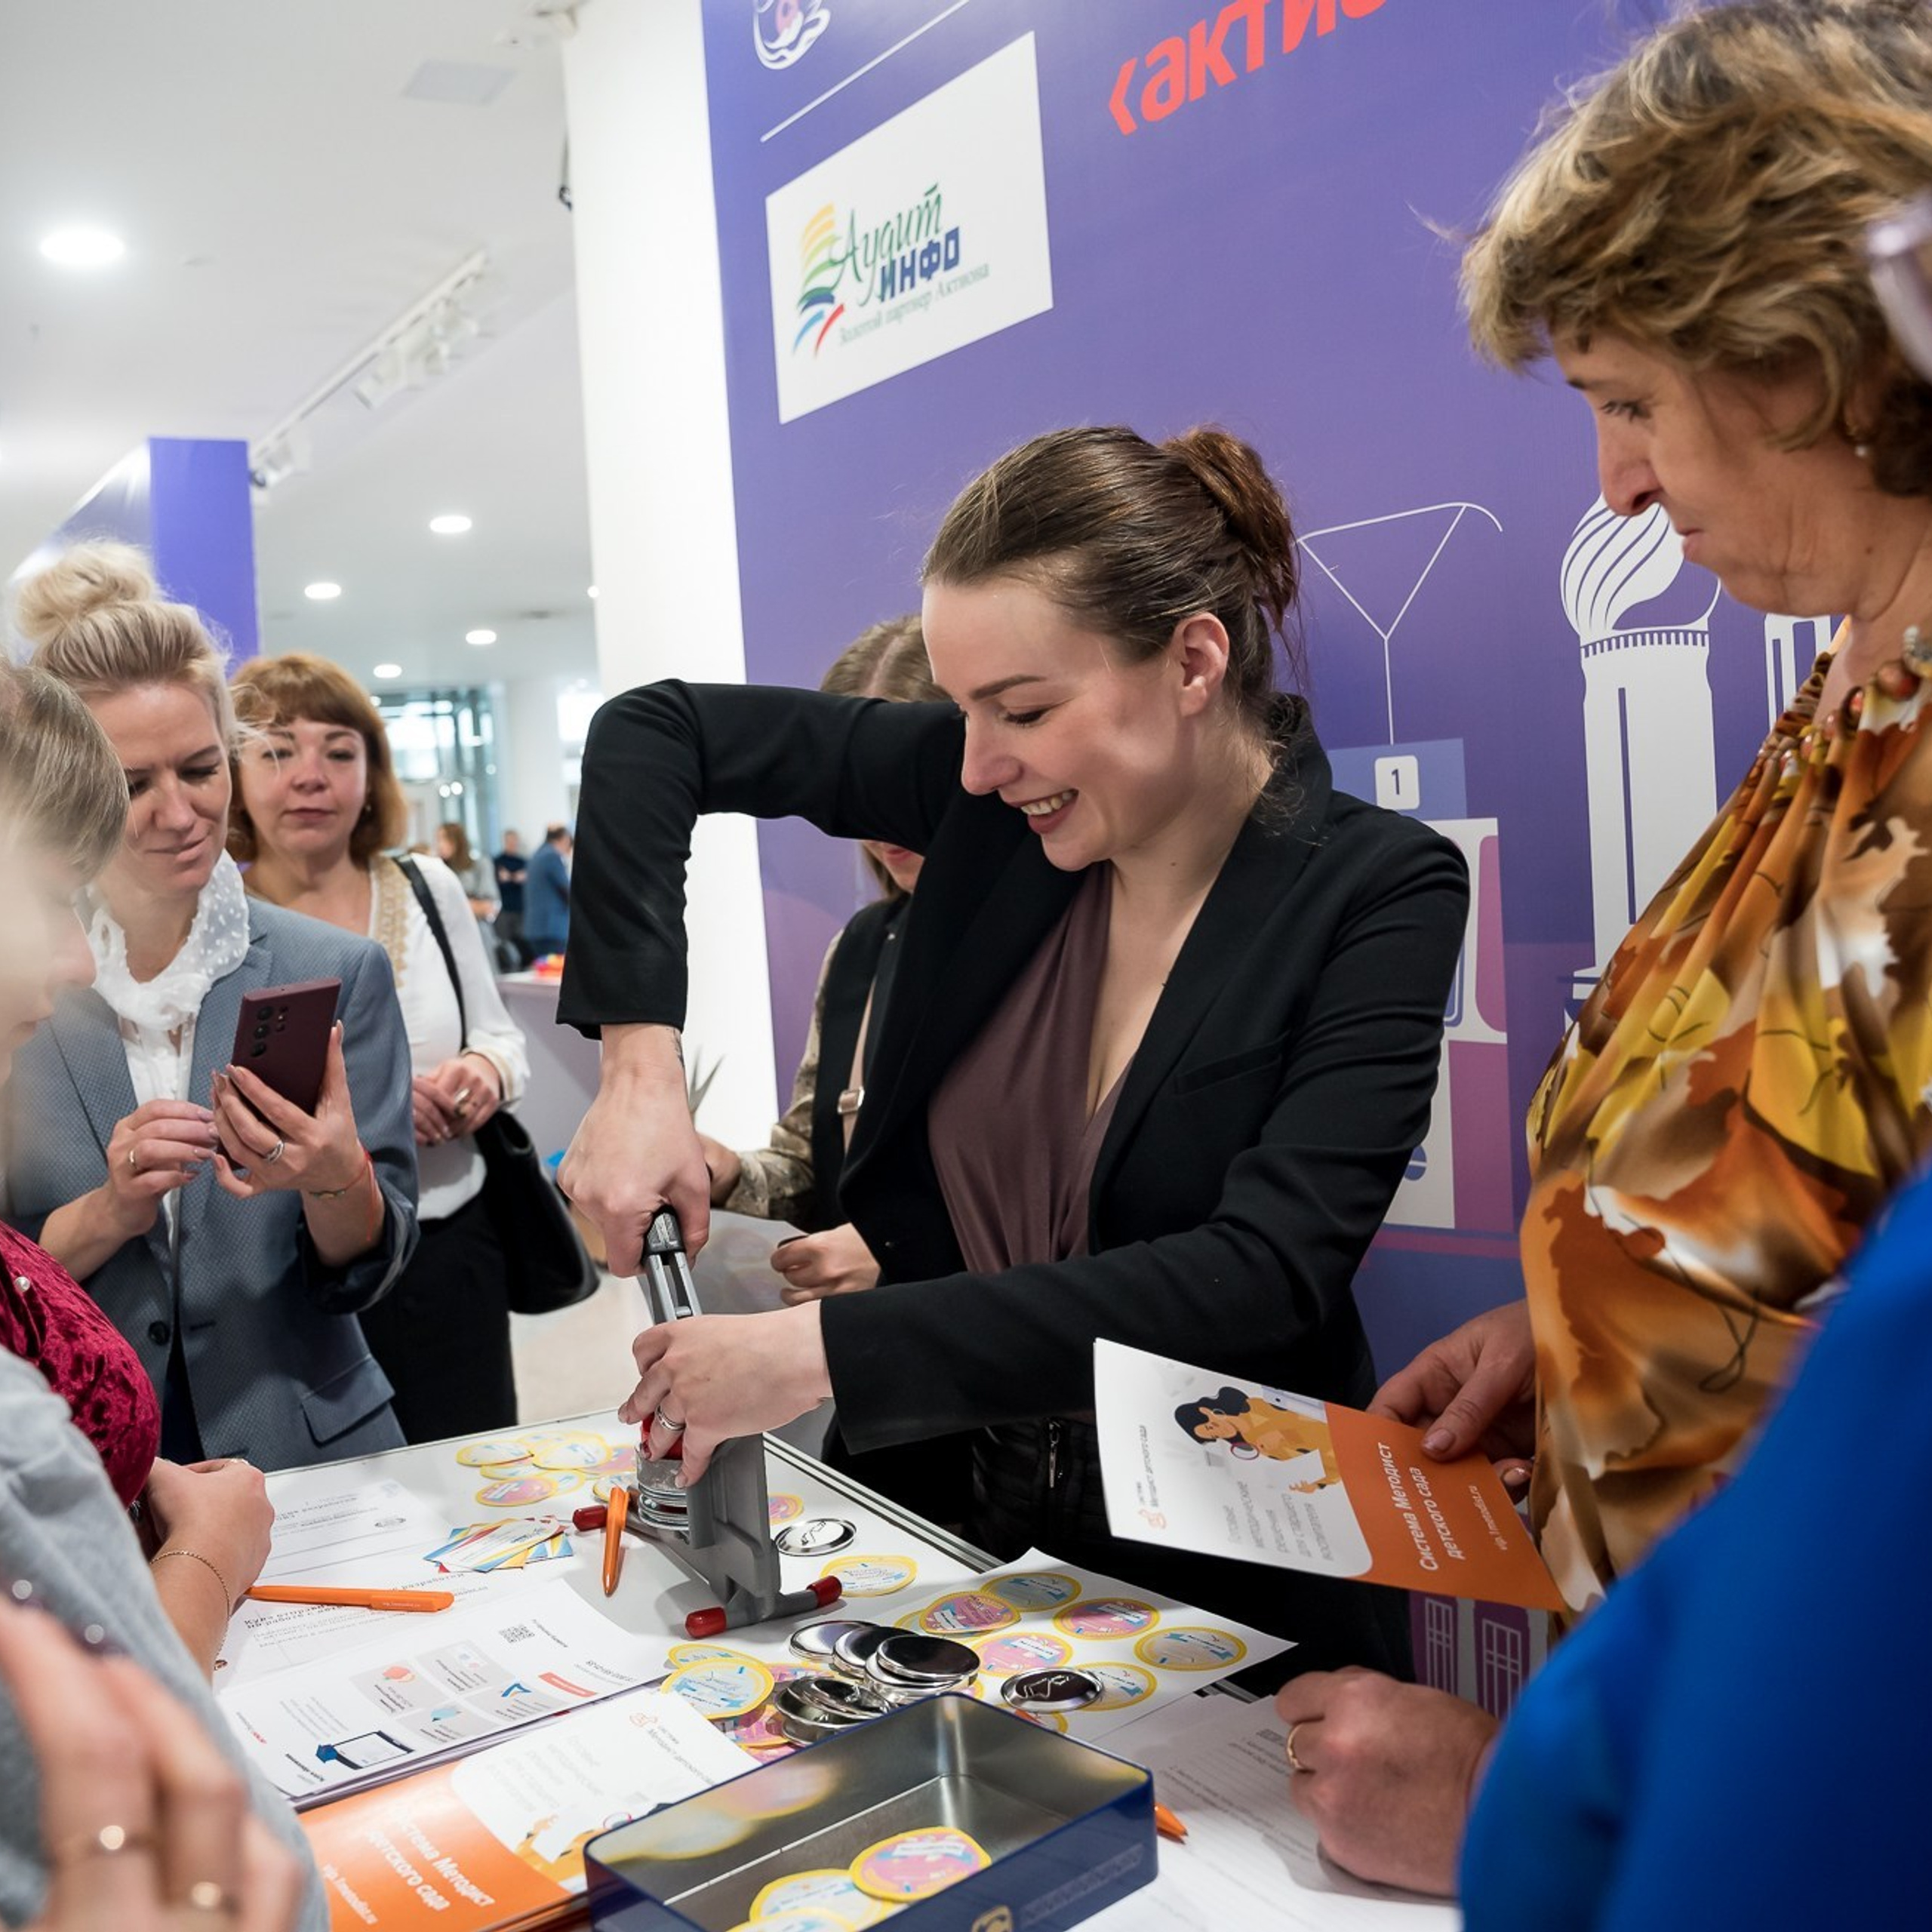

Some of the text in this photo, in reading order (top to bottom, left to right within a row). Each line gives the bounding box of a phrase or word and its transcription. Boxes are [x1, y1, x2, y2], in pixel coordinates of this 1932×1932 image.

[830, 182, 943, 306] Аудит
[879, 226, 960, 303] ИНФО
[1392, 768, 1401, 795] 1
[1378, 1441, 1438, 1571] Система Методист
[1409, 1467, 1466, 1560] детского сада
